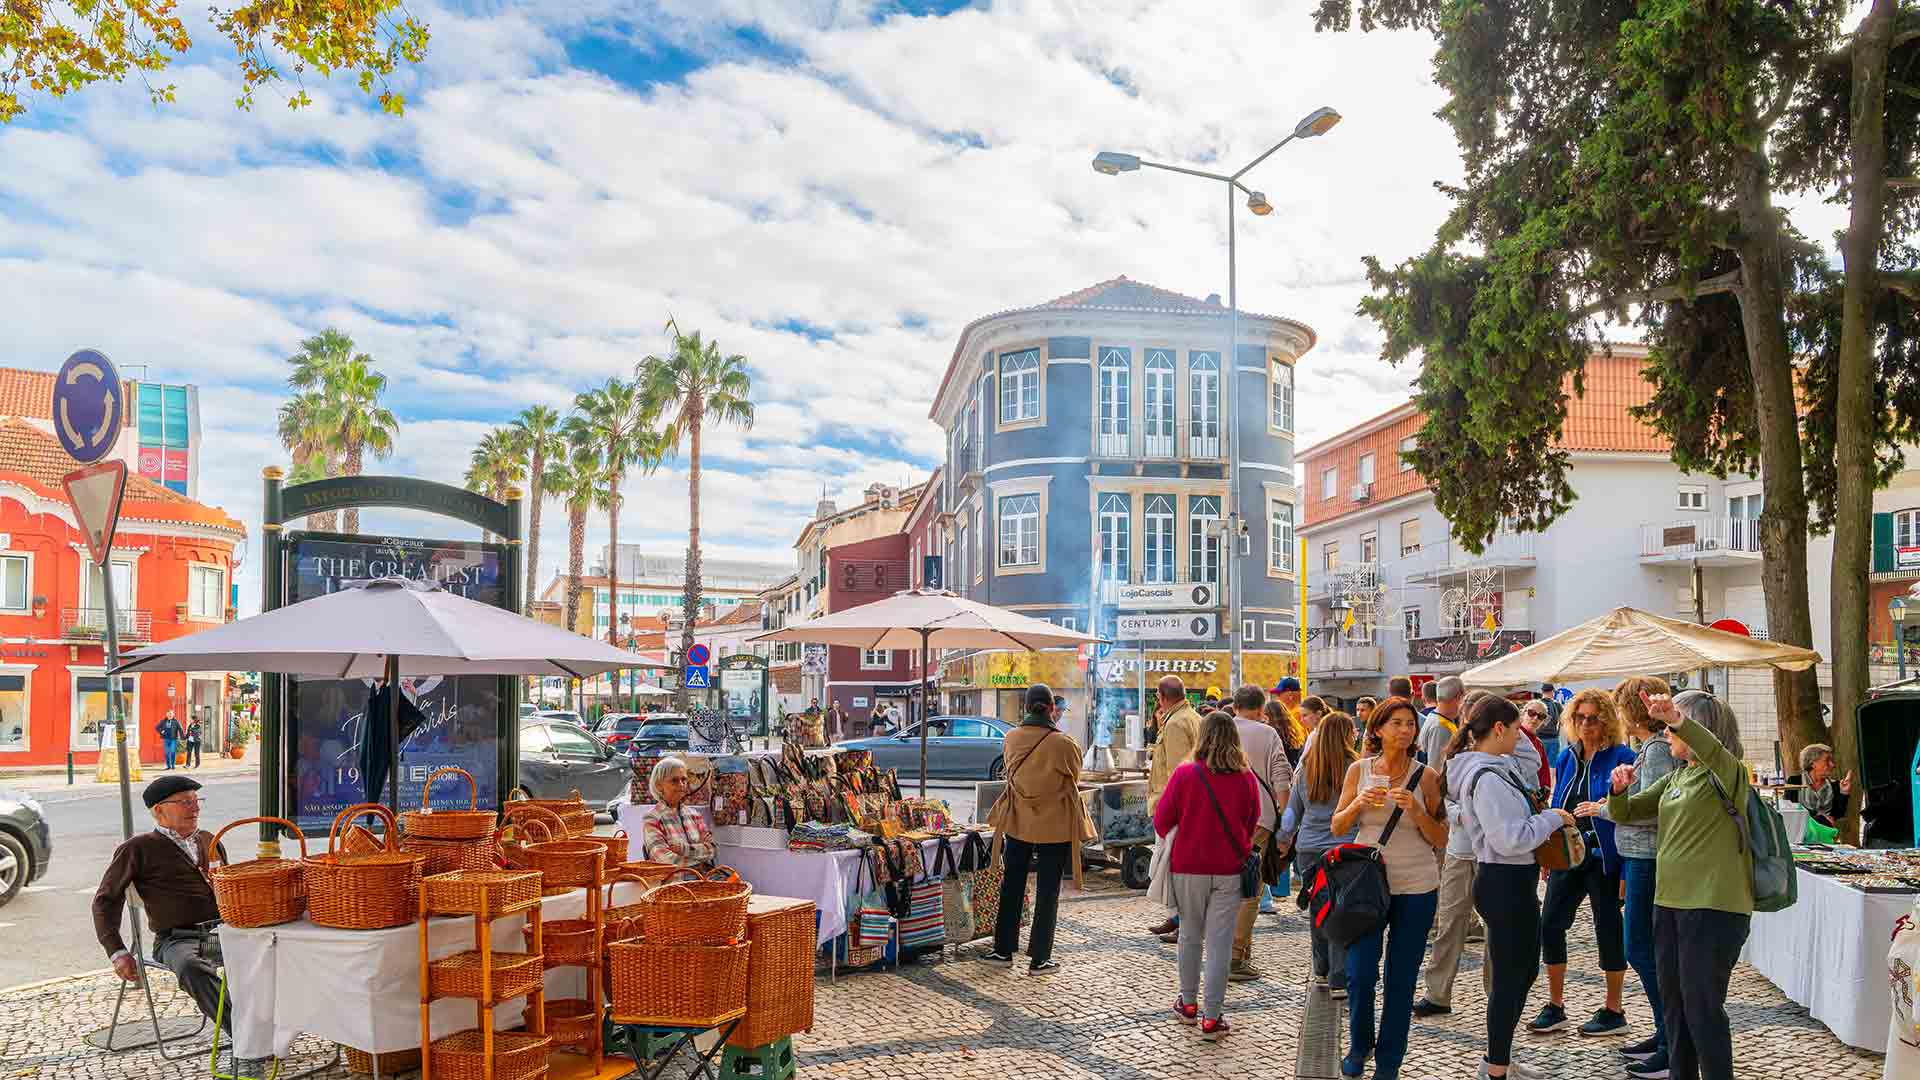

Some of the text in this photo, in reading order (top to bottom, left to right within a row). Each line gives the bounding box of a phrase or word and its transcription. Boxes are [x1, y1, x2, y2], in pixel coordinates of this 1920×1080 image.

[312, 557, 484, 585] THE GREATEST
[1121, 619, 1181, 629] CENTURY 21
[1126, 659, 1217, 673] TORRES
